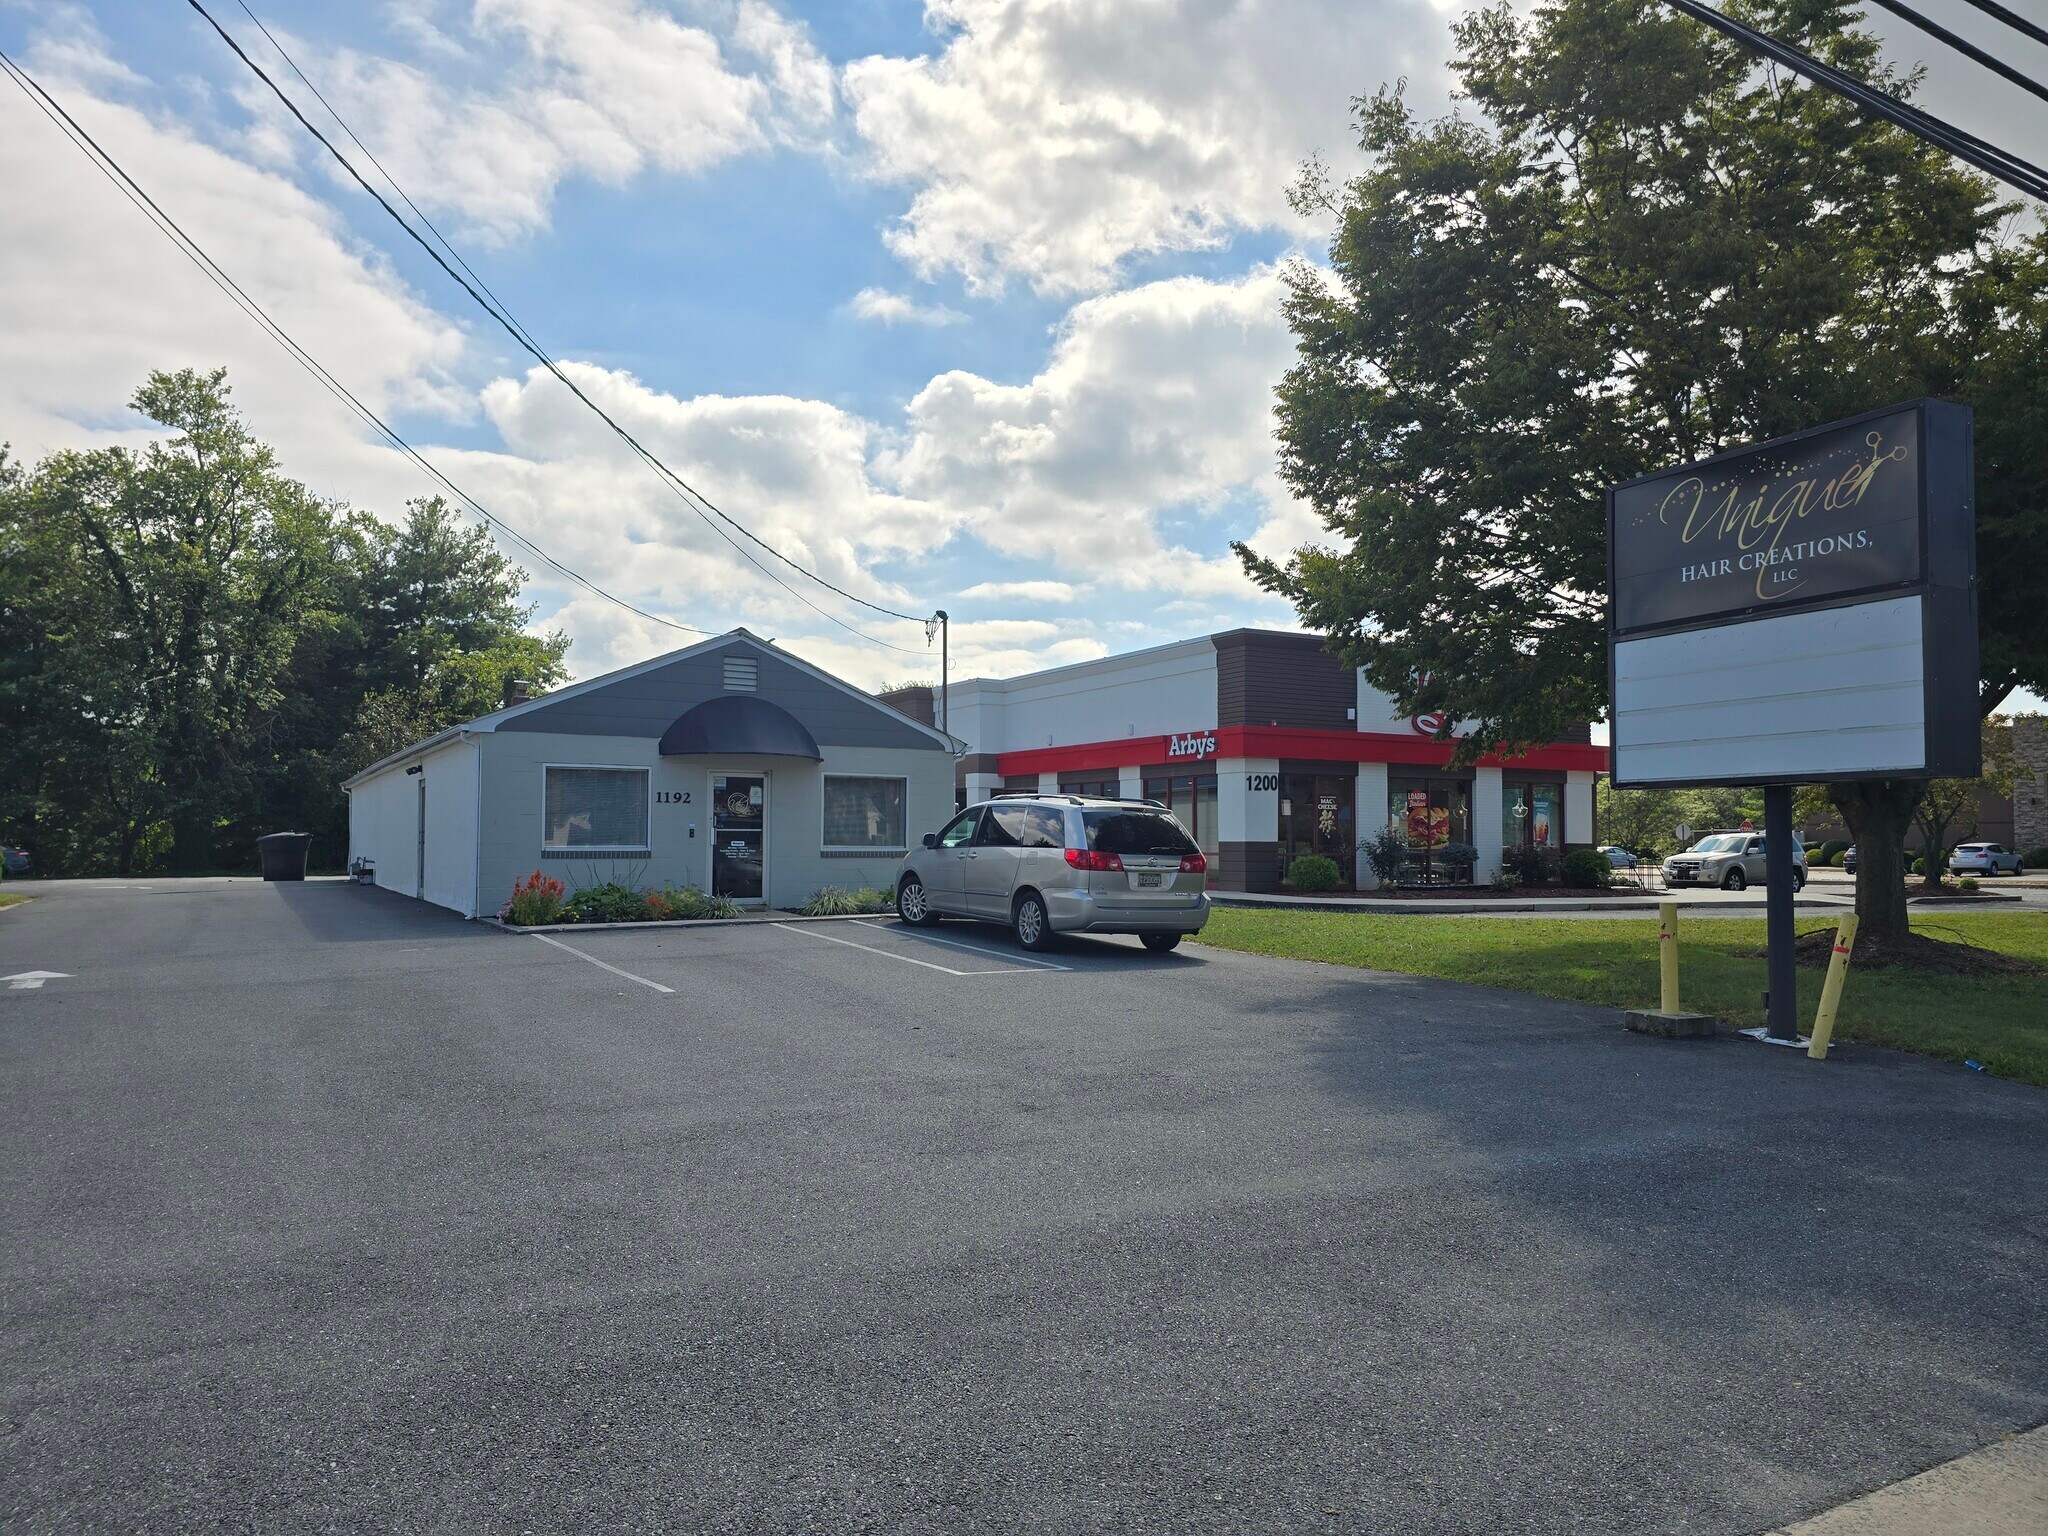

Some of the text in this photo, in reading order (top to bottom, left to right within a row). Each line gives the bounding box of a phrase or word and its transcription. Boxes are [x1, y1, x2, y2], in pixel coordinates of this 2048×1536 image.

[1660, 464, 1866, 599] Unique
[1681, 530, 1873, 583] HAIR CREATIONS,
[1773, 568, 1798, 583] LLC
[1169, 731, 1215, 759] Arby's
[1246, 775, 1278, 791] 1200
[656, 791, 691, 804] 1192
[1407, 792, 1427, 800] LOADED
